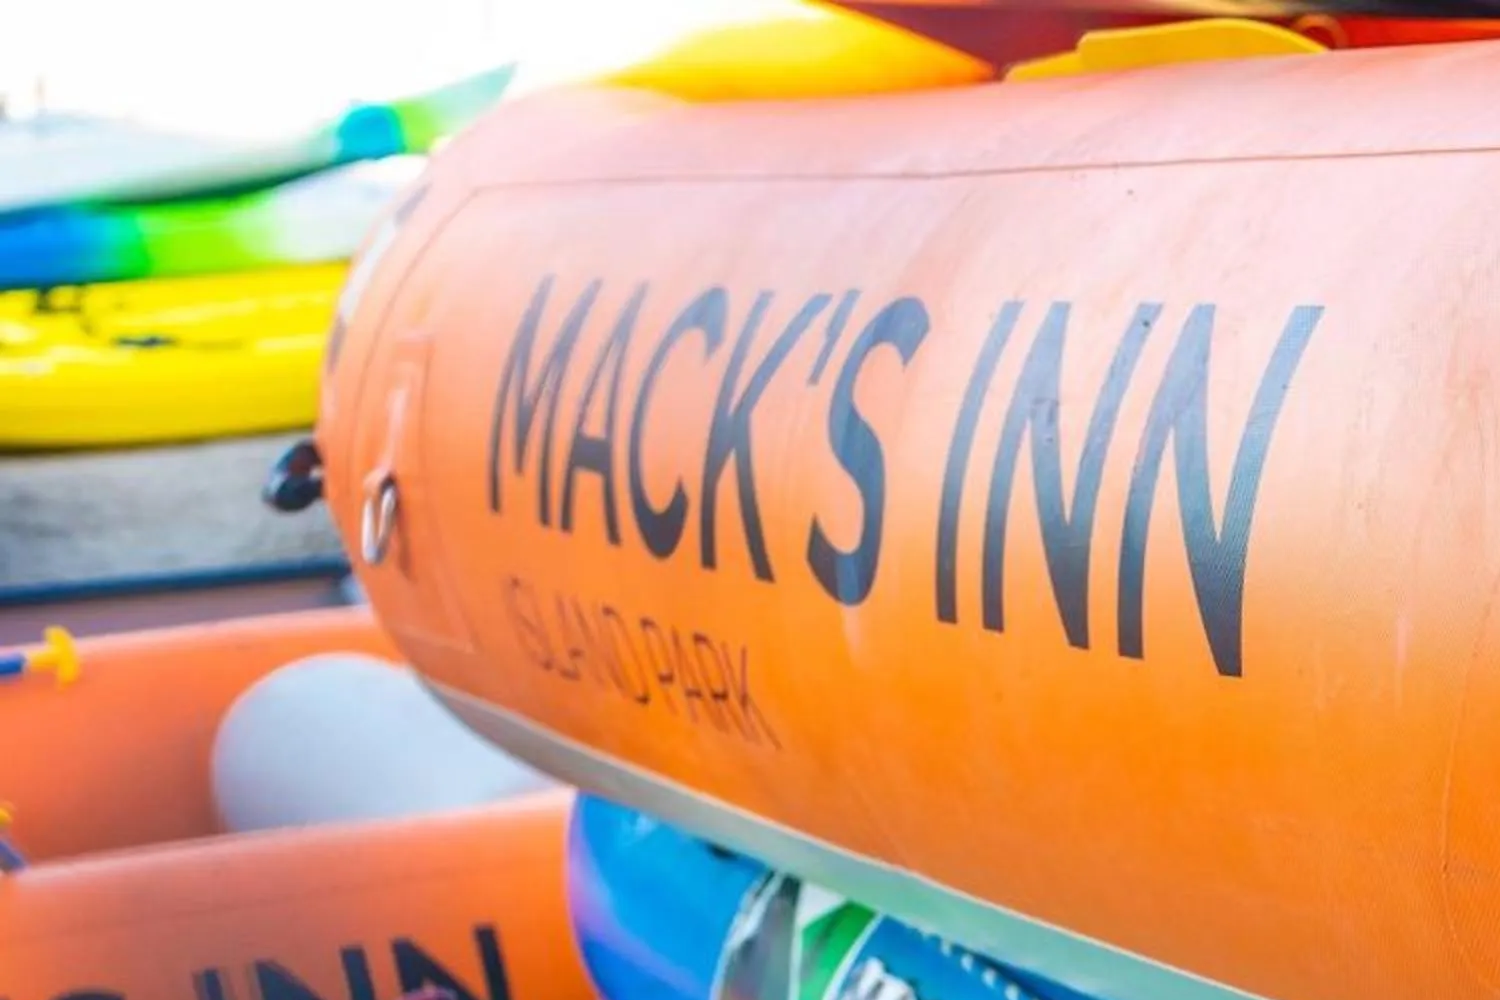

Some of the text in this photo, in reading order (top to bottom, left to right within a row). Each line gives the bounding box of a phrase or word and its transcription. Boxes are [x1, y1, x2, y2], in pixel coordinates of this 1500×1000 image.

[487, 273, 1326, 678] MACK'S INN
[640, 617, 783, 751] PARK
